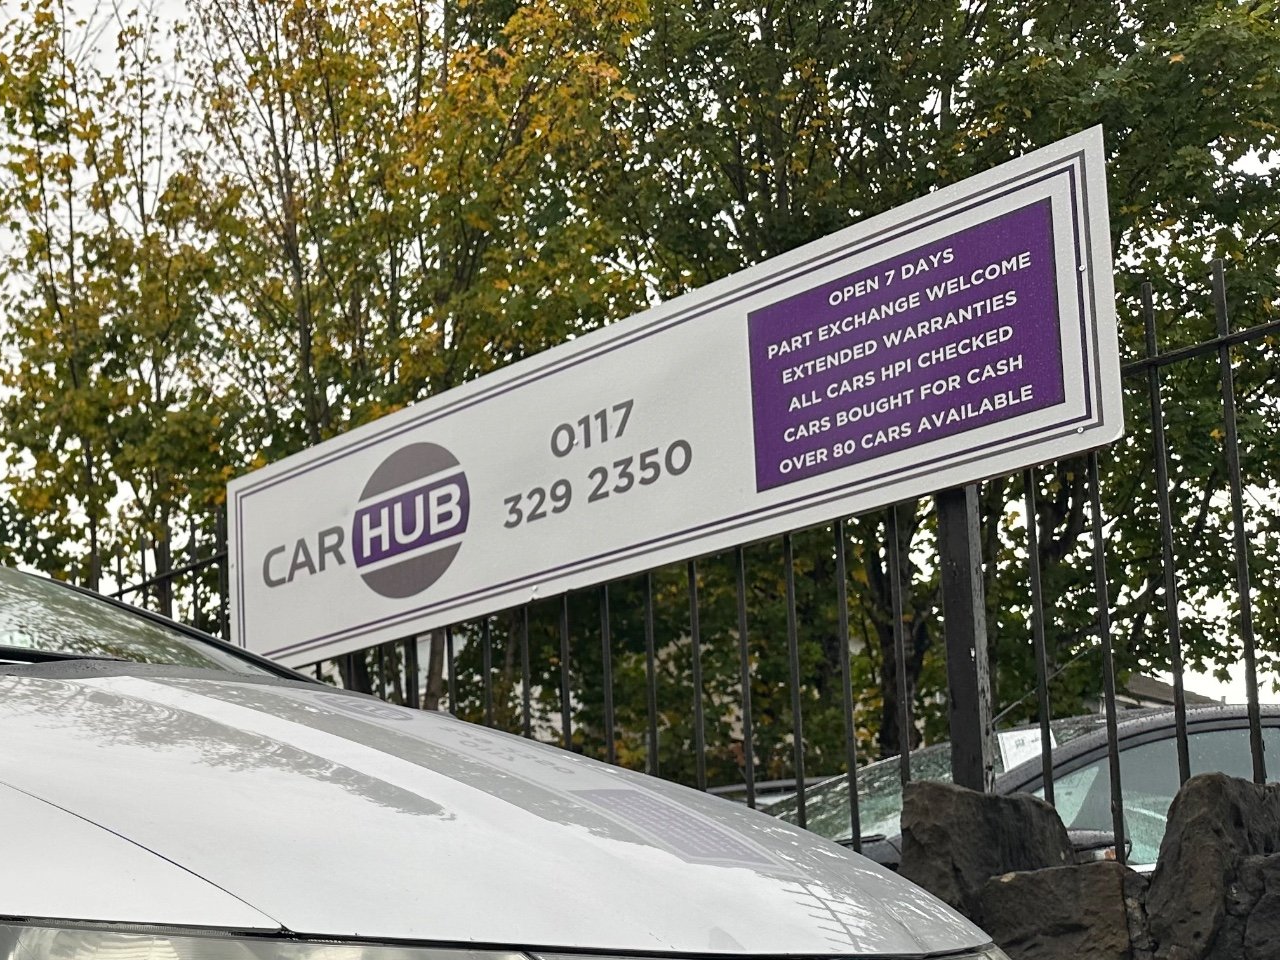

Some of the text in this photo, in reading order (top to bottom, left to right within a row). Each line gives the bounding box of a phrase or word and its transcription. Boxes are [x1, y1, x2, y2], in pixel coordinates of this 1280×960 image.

[768, 252, 1031, 359] PART EXCHANGE WELCOME
[829, 249, 954, 305] OPEN 7 DAYS
[782, 291, 1017, 384] EXTENDED WARRANTIES
[789, 326, 1013, 411] ALL CARS HPI CHECKED
[551, 400, 634, 457] 0117
[780, 385, 1033, 473] OVER 80 CARS AVAILABLE
[784, 355, 1022, 442] CARS BOUGHT FOR CASH
[503, 439, 693, 528] 329 2350
[263, 483, 462, 588] CAR HUB
